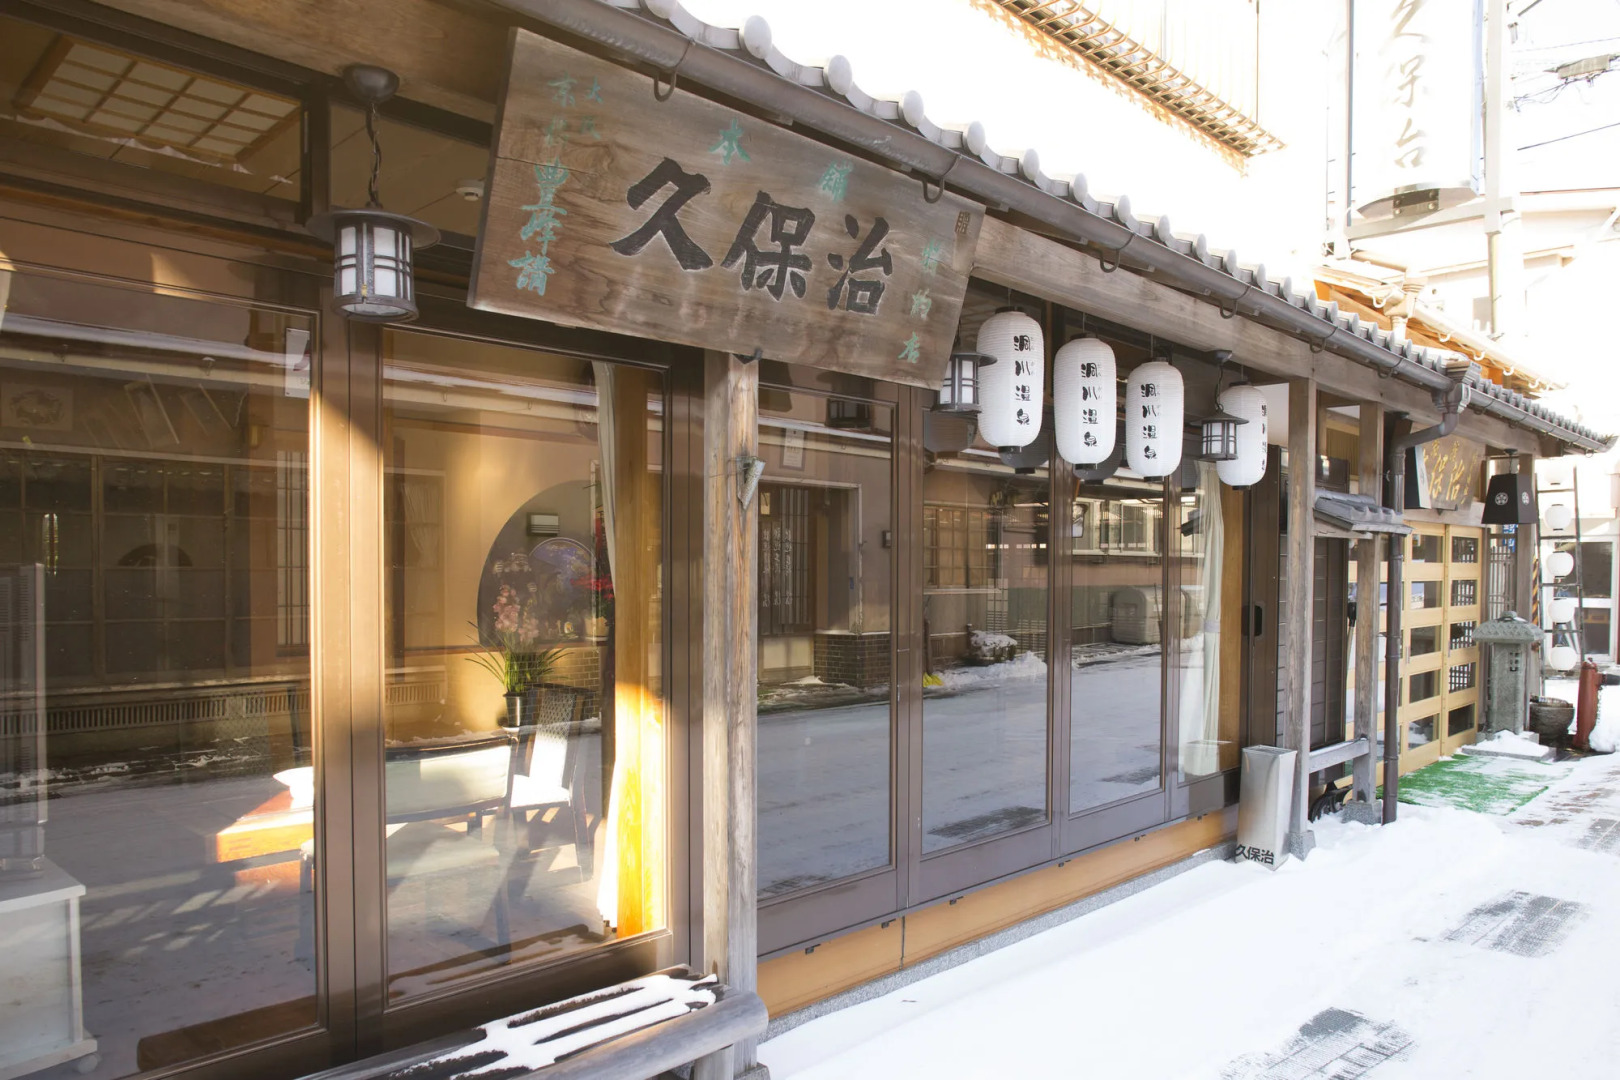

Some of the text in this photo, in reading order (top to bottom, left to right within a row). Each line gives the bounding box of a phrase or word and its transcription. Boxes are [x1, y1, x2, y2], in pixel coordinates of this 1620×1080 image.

[608, 156, 894, 316] 久保治
[1235, 844, 1275, 866] 久保治
